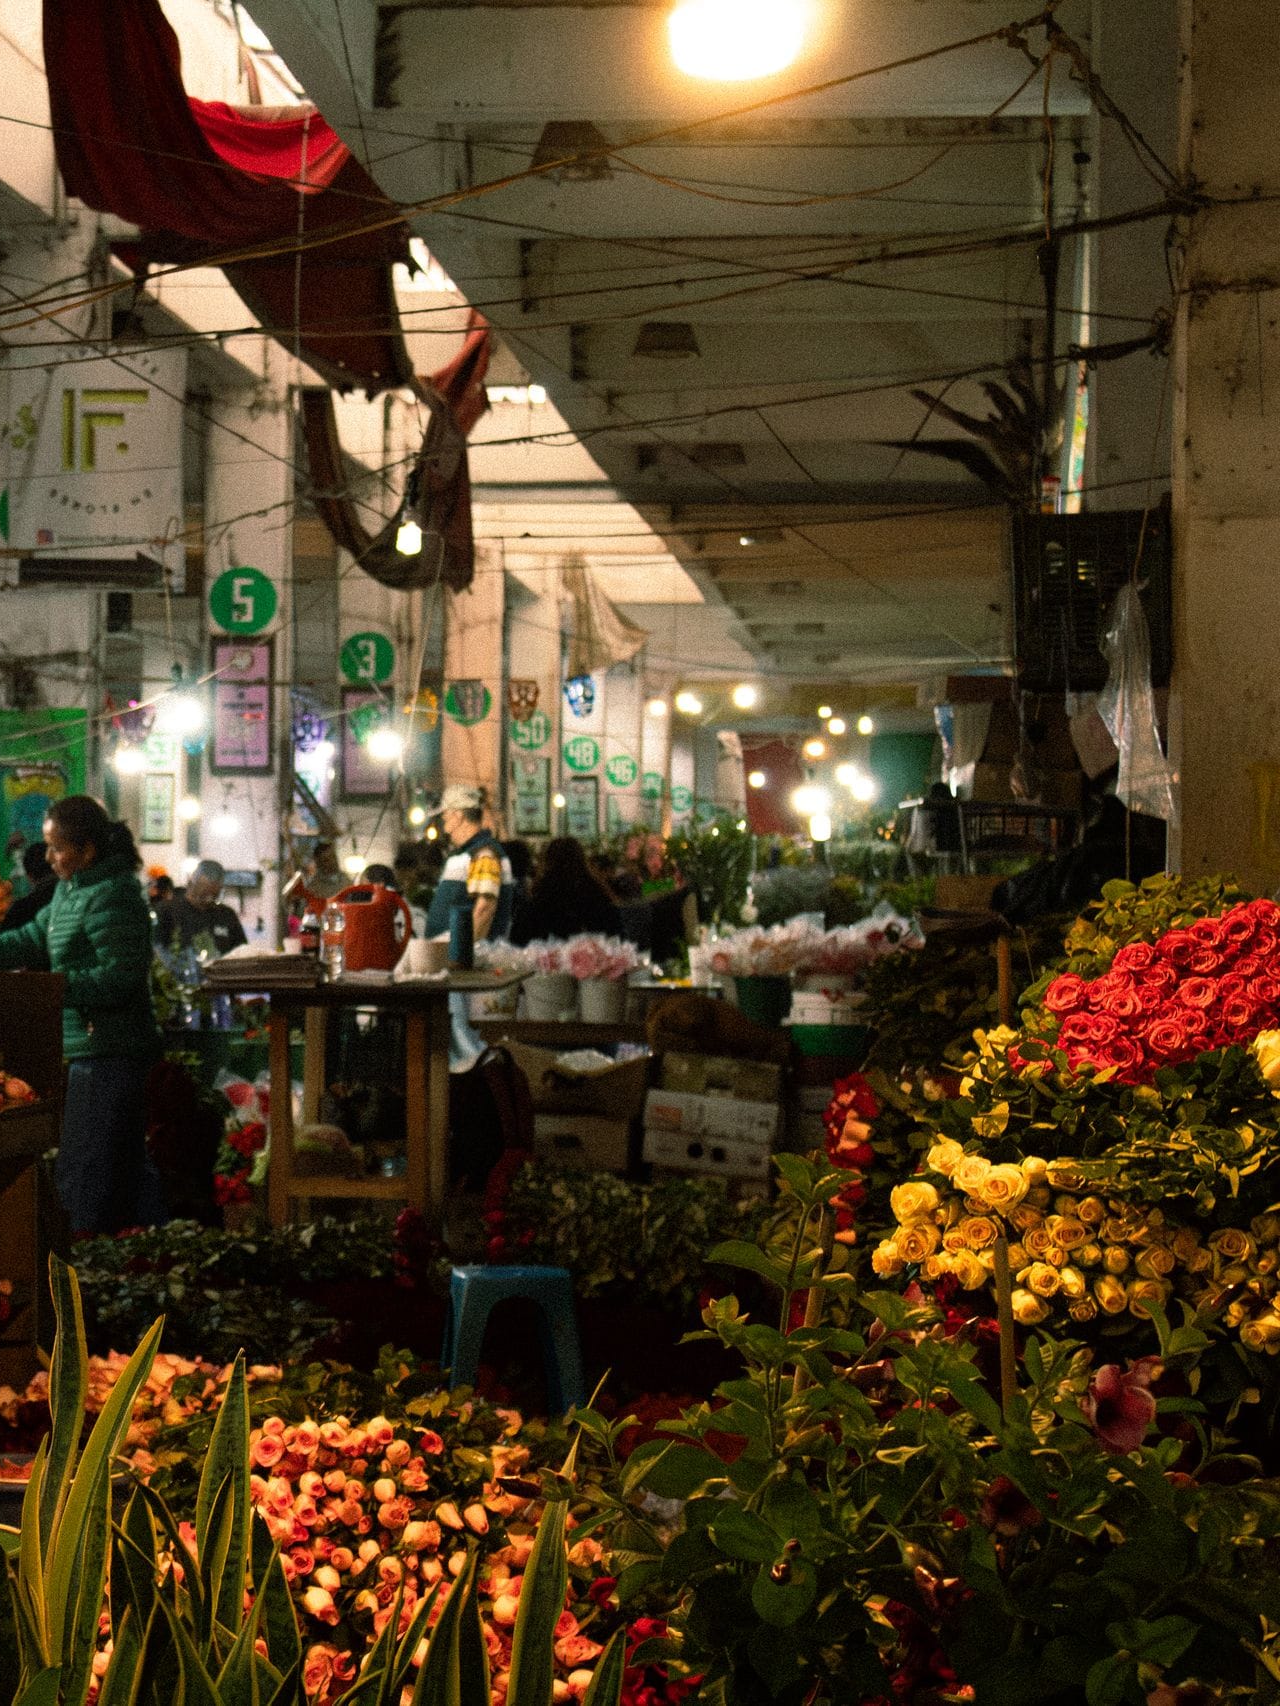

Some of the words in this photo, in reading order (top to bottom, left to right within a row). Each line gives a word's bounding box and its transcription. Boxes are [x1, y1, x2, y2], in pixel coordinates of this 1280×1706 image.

[232, 578, 254, 622] 5
[357, 640, 376, 678] 3
[568, 741, 594, 768] 48
